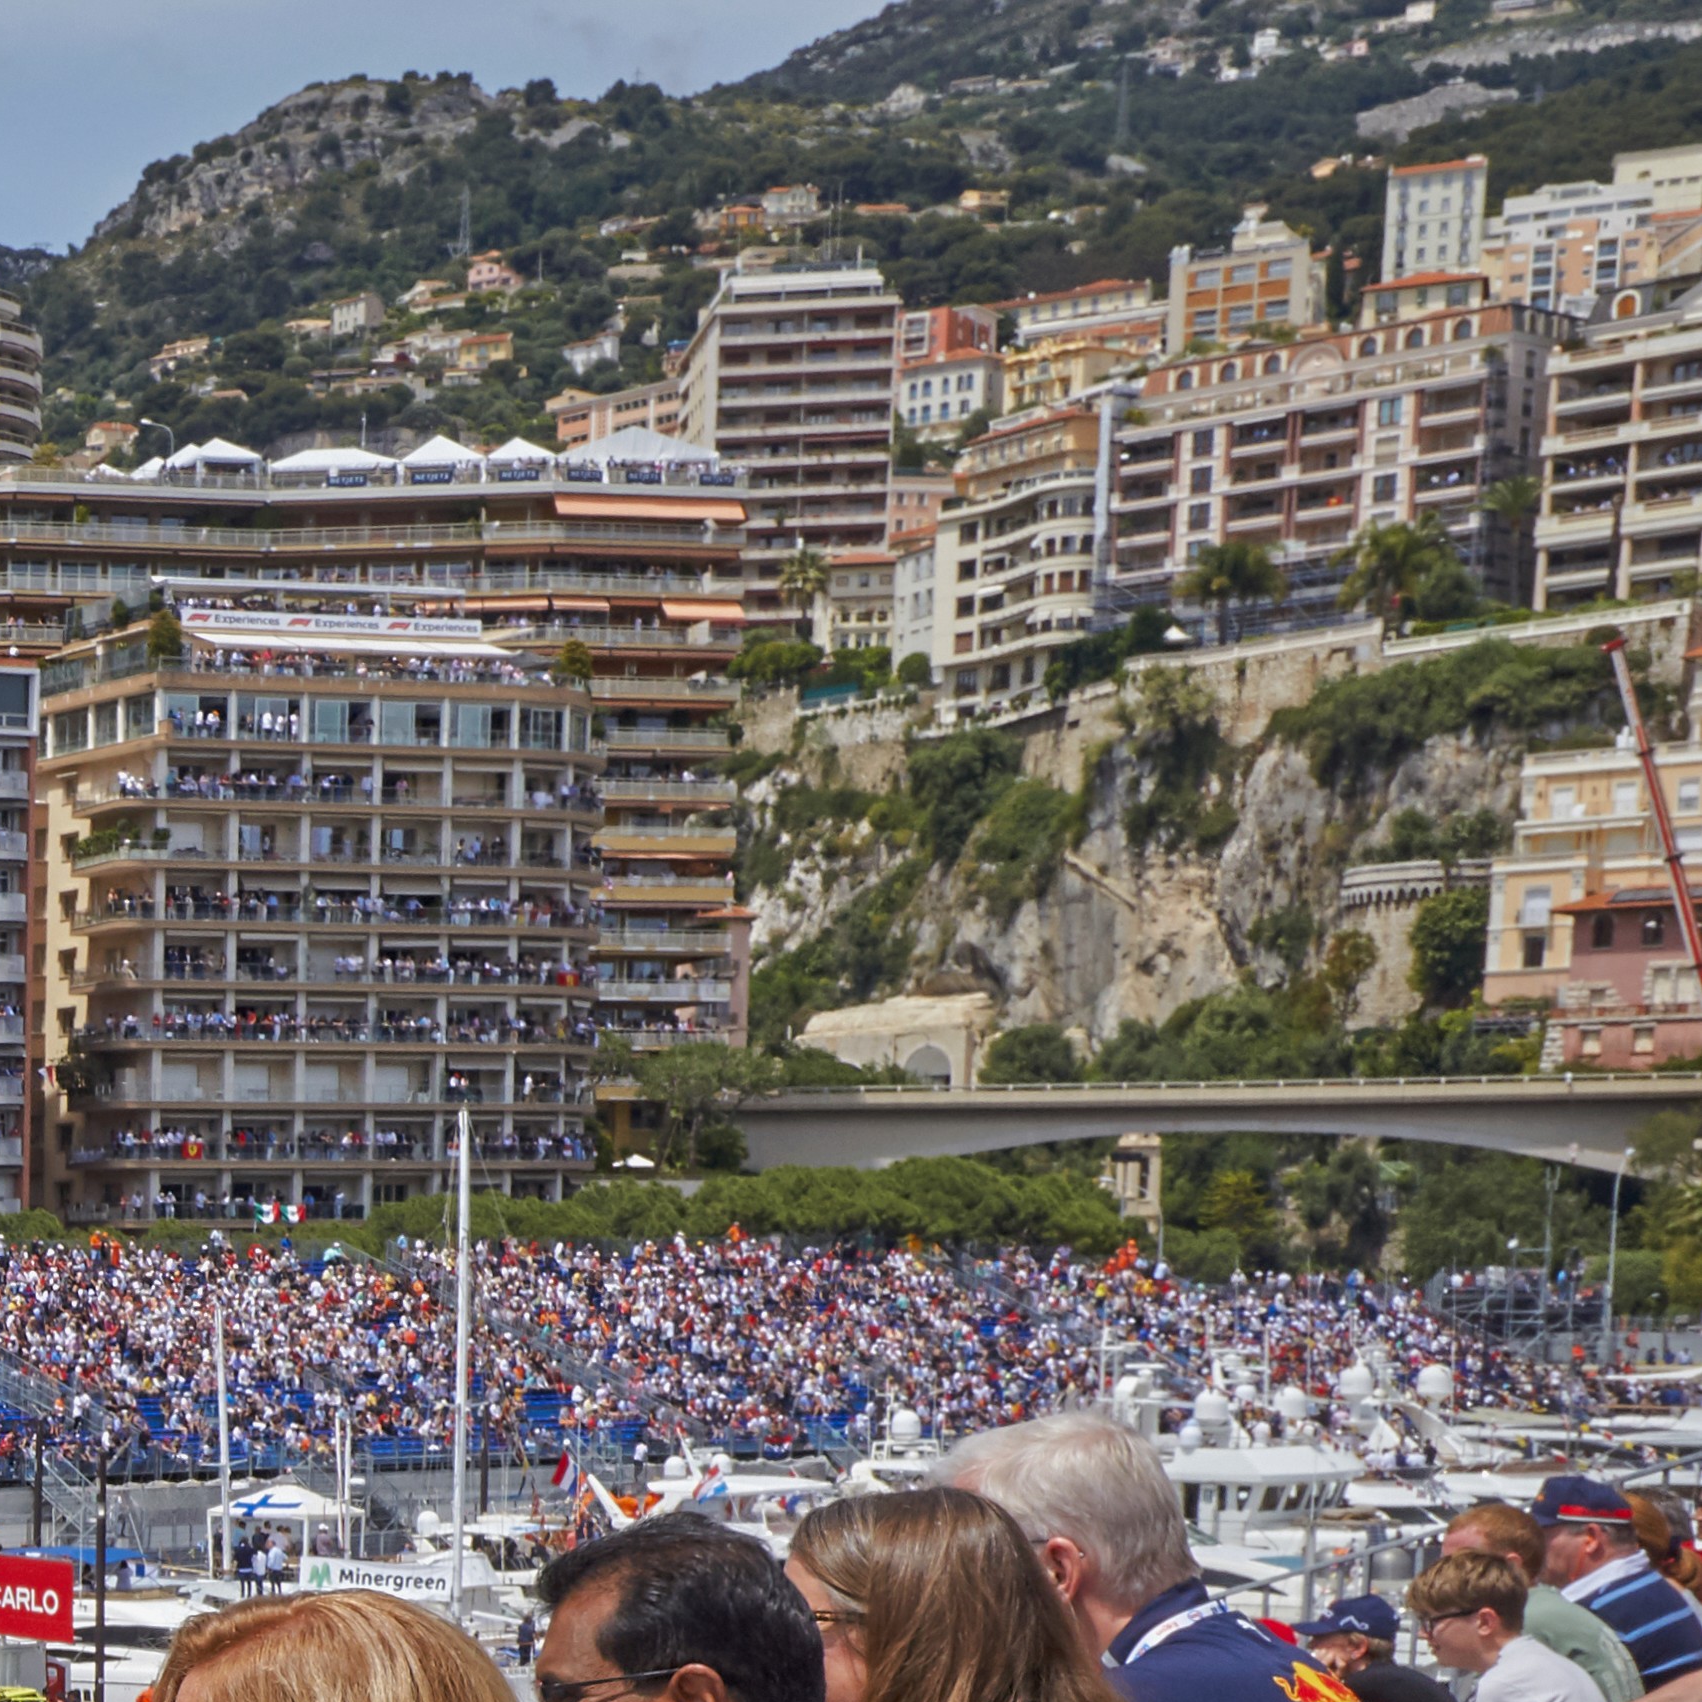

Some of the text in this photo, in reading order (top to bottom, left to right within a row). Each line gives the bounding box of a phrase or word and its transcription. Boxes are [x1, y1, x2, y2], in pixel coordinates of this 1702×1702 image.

[414, 472, 449, 482] NETJETS
[502, 470, 536, 479] NETJETS
[214, 613, 280, 626] Experiences
[315, 618, 379, 631] Experiences
[413, 621, 478, 634] Experiences
[338, 1568, 446, 1591] Minergreen
